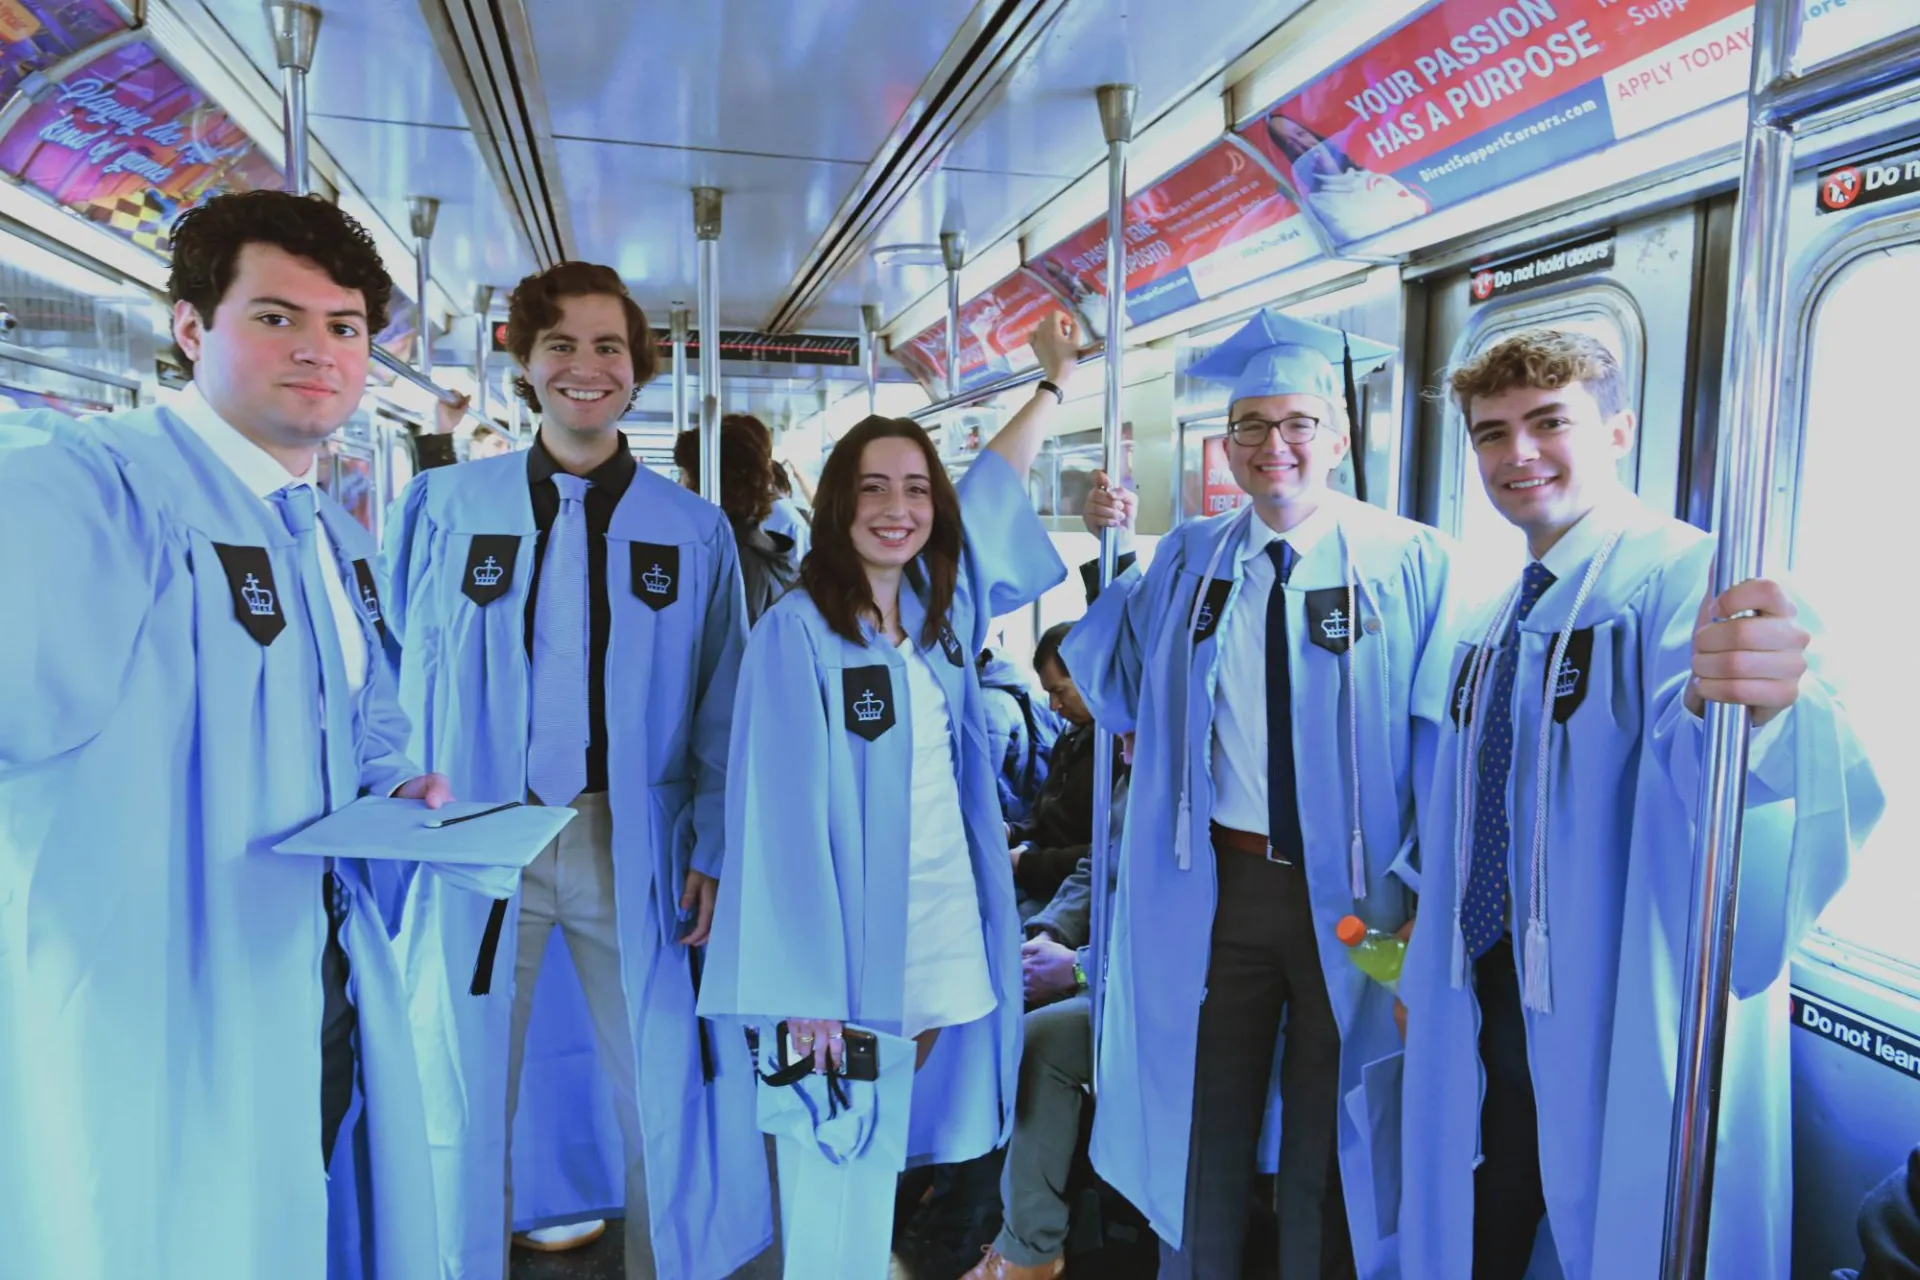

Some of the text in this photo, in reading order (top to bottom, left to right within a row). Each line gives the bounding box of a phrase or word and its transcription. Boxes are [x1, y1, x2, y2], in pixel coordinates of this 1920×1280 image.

[1344, 0, 1558, 122] YOUR PASSION
[1366, 19, 1601, 159] HAS A PURPOSE
[1616, 61, 1674, 101] APPLY
[57, 78, 184, 146] Playing the
[1418, 99, 1598, 183] DirectSupportCareers.com
[1864, 165, 1901, 191] Do
[1494, 242, 1609, 288] Do not hold doors
[1802, 1003, 1920, 1076] Do not lean
